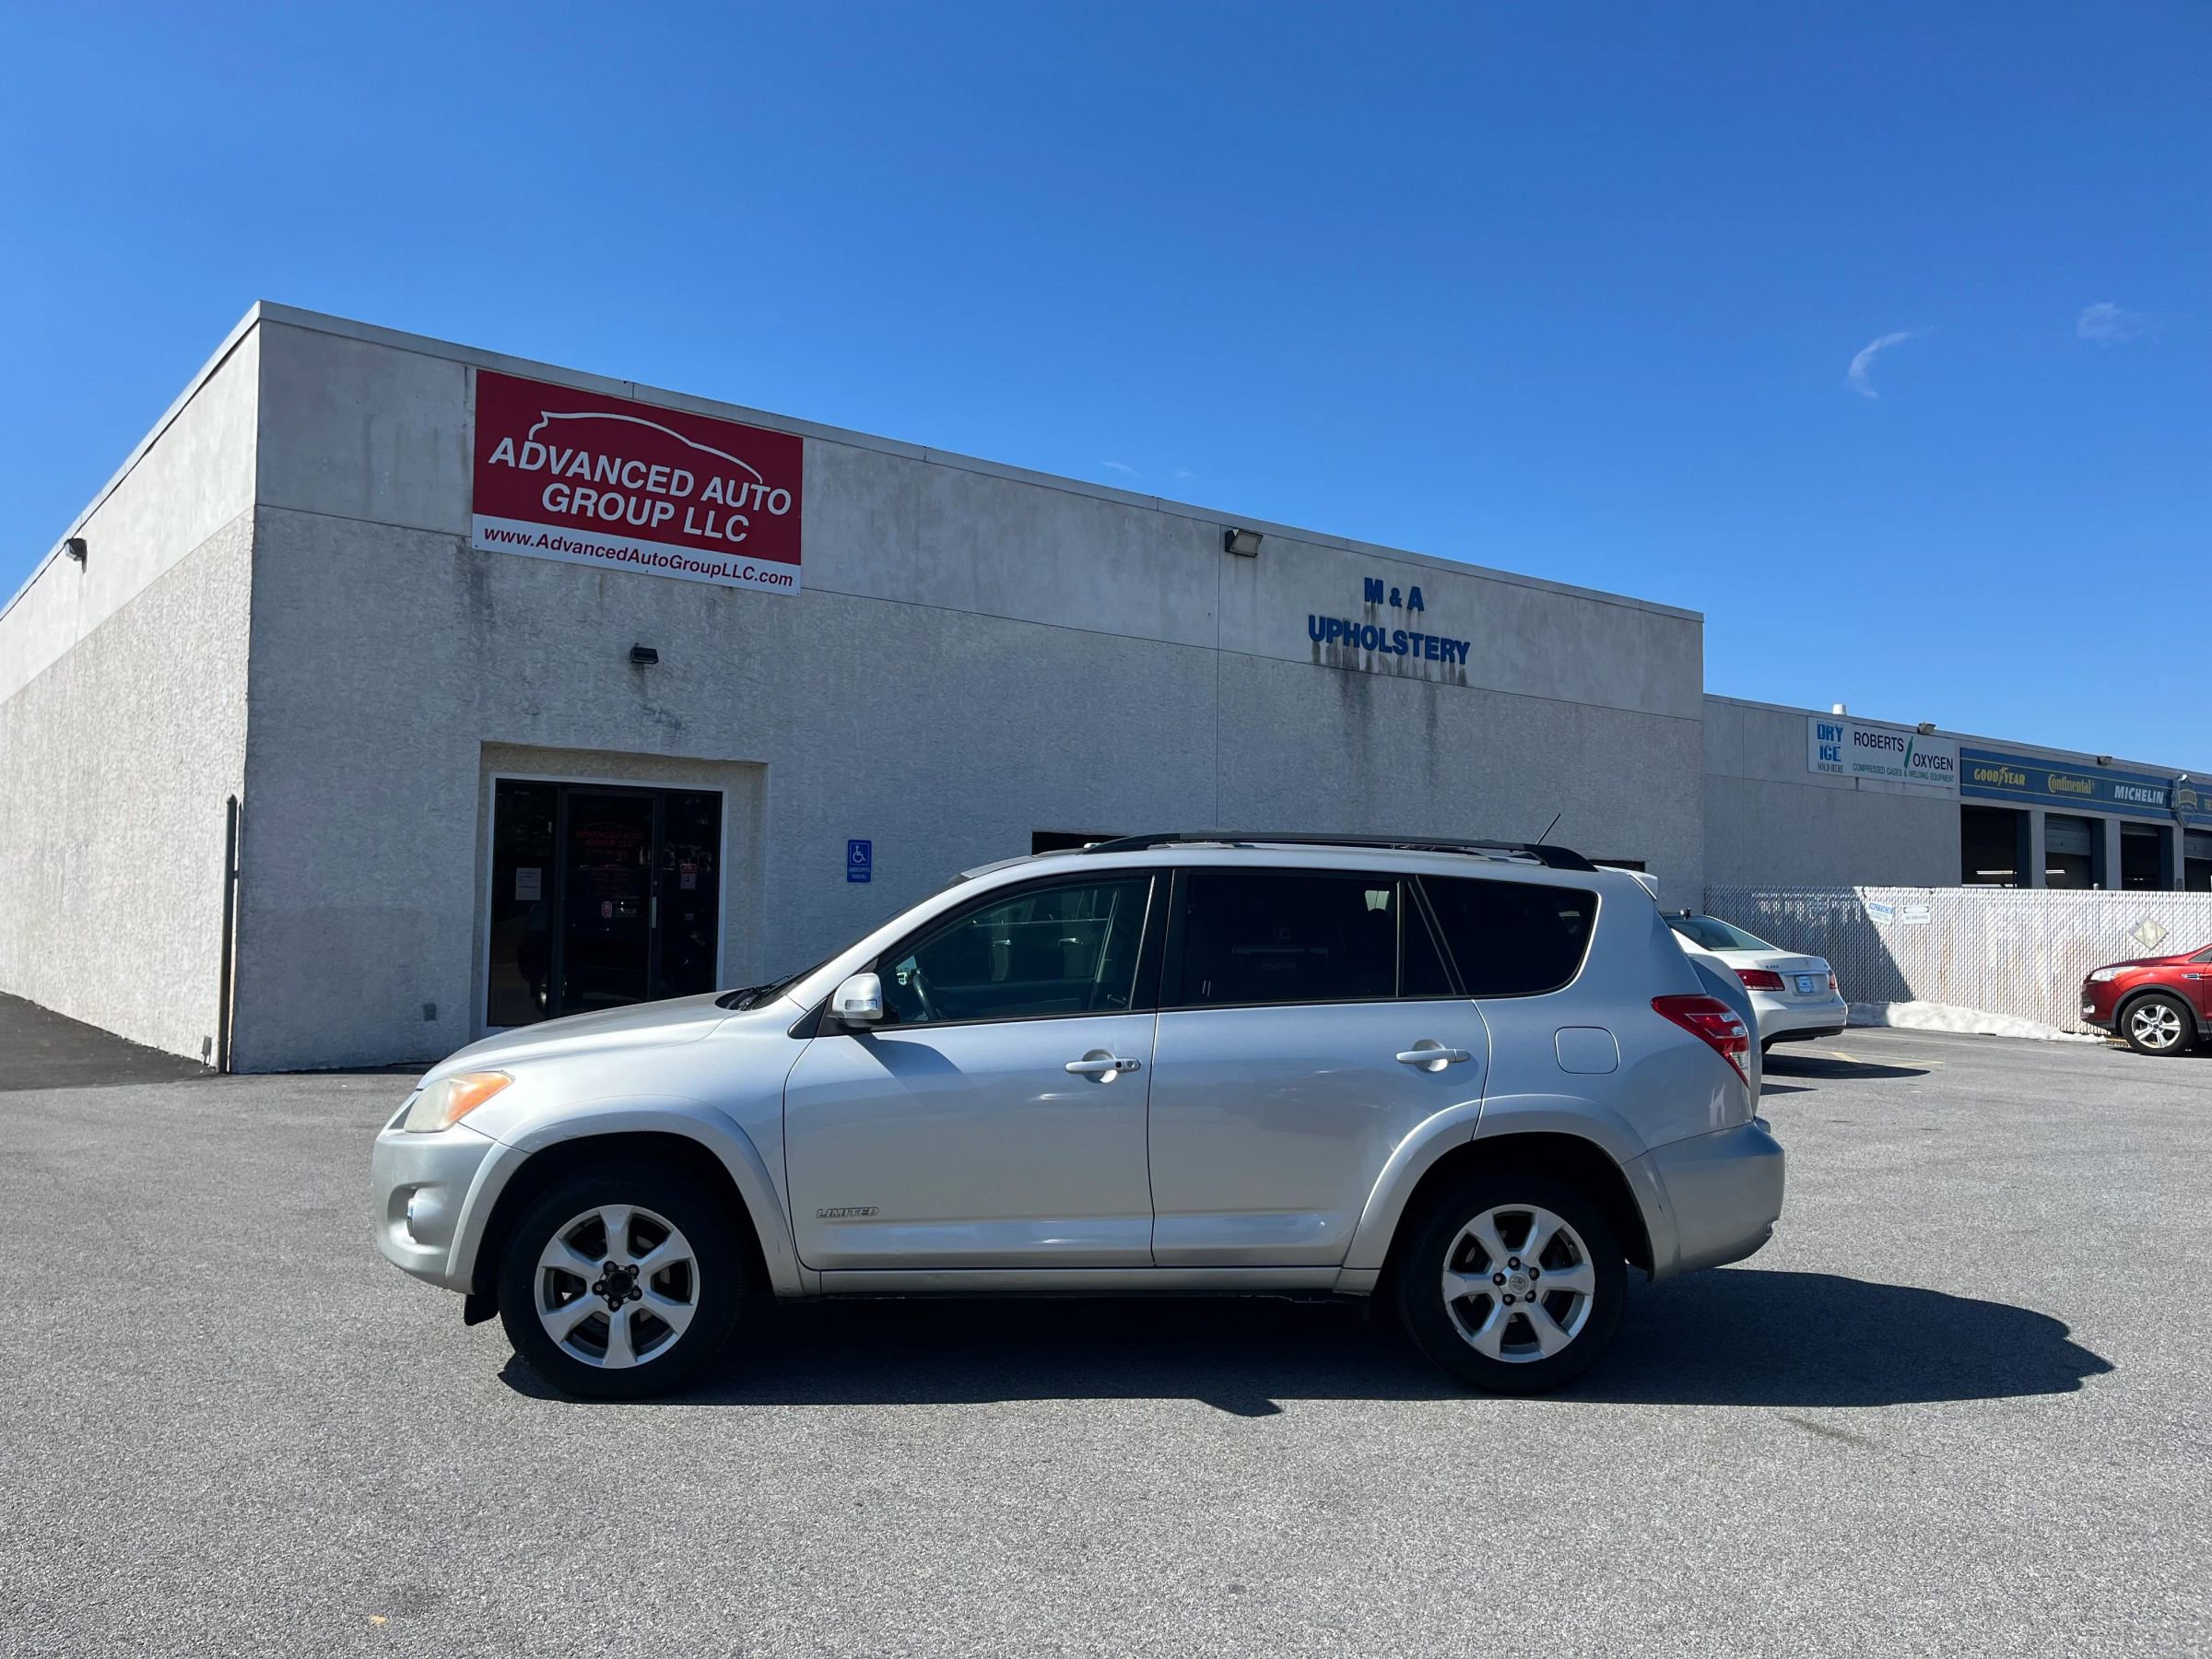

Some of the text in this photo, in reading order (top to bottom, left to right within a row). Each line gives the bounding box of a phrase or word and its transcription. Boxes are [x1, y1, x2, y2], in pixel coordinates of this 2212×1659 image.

[488, 437, 793, 516] ADVANCED AUTO
[541, 482, 750, 542] GROUP LLC
[483, 526, 794, 587] www.AdvancedAutoGroupLLC.com
[1364, 576, 1425, 612] M & A
[1308, 614, 1471, 665] UPHOLSTERY
[1817, 724, 1843, 743] DRY
[1853, 731, 1904, 752] ROBERTS
[1819, 744, 1841, 762] ICE
[1912, 752, 1954, 771] OXYGEN
[1853, 762, 1886, 775] COMPRESSED
[1973, 766, 2026, 786] GOODYEAR
[2048, 774, 2091, 794] Continental
[2114, 785, 2164, 805] MICHELIN
[816, 1206, 879, 1218] LIMITED
